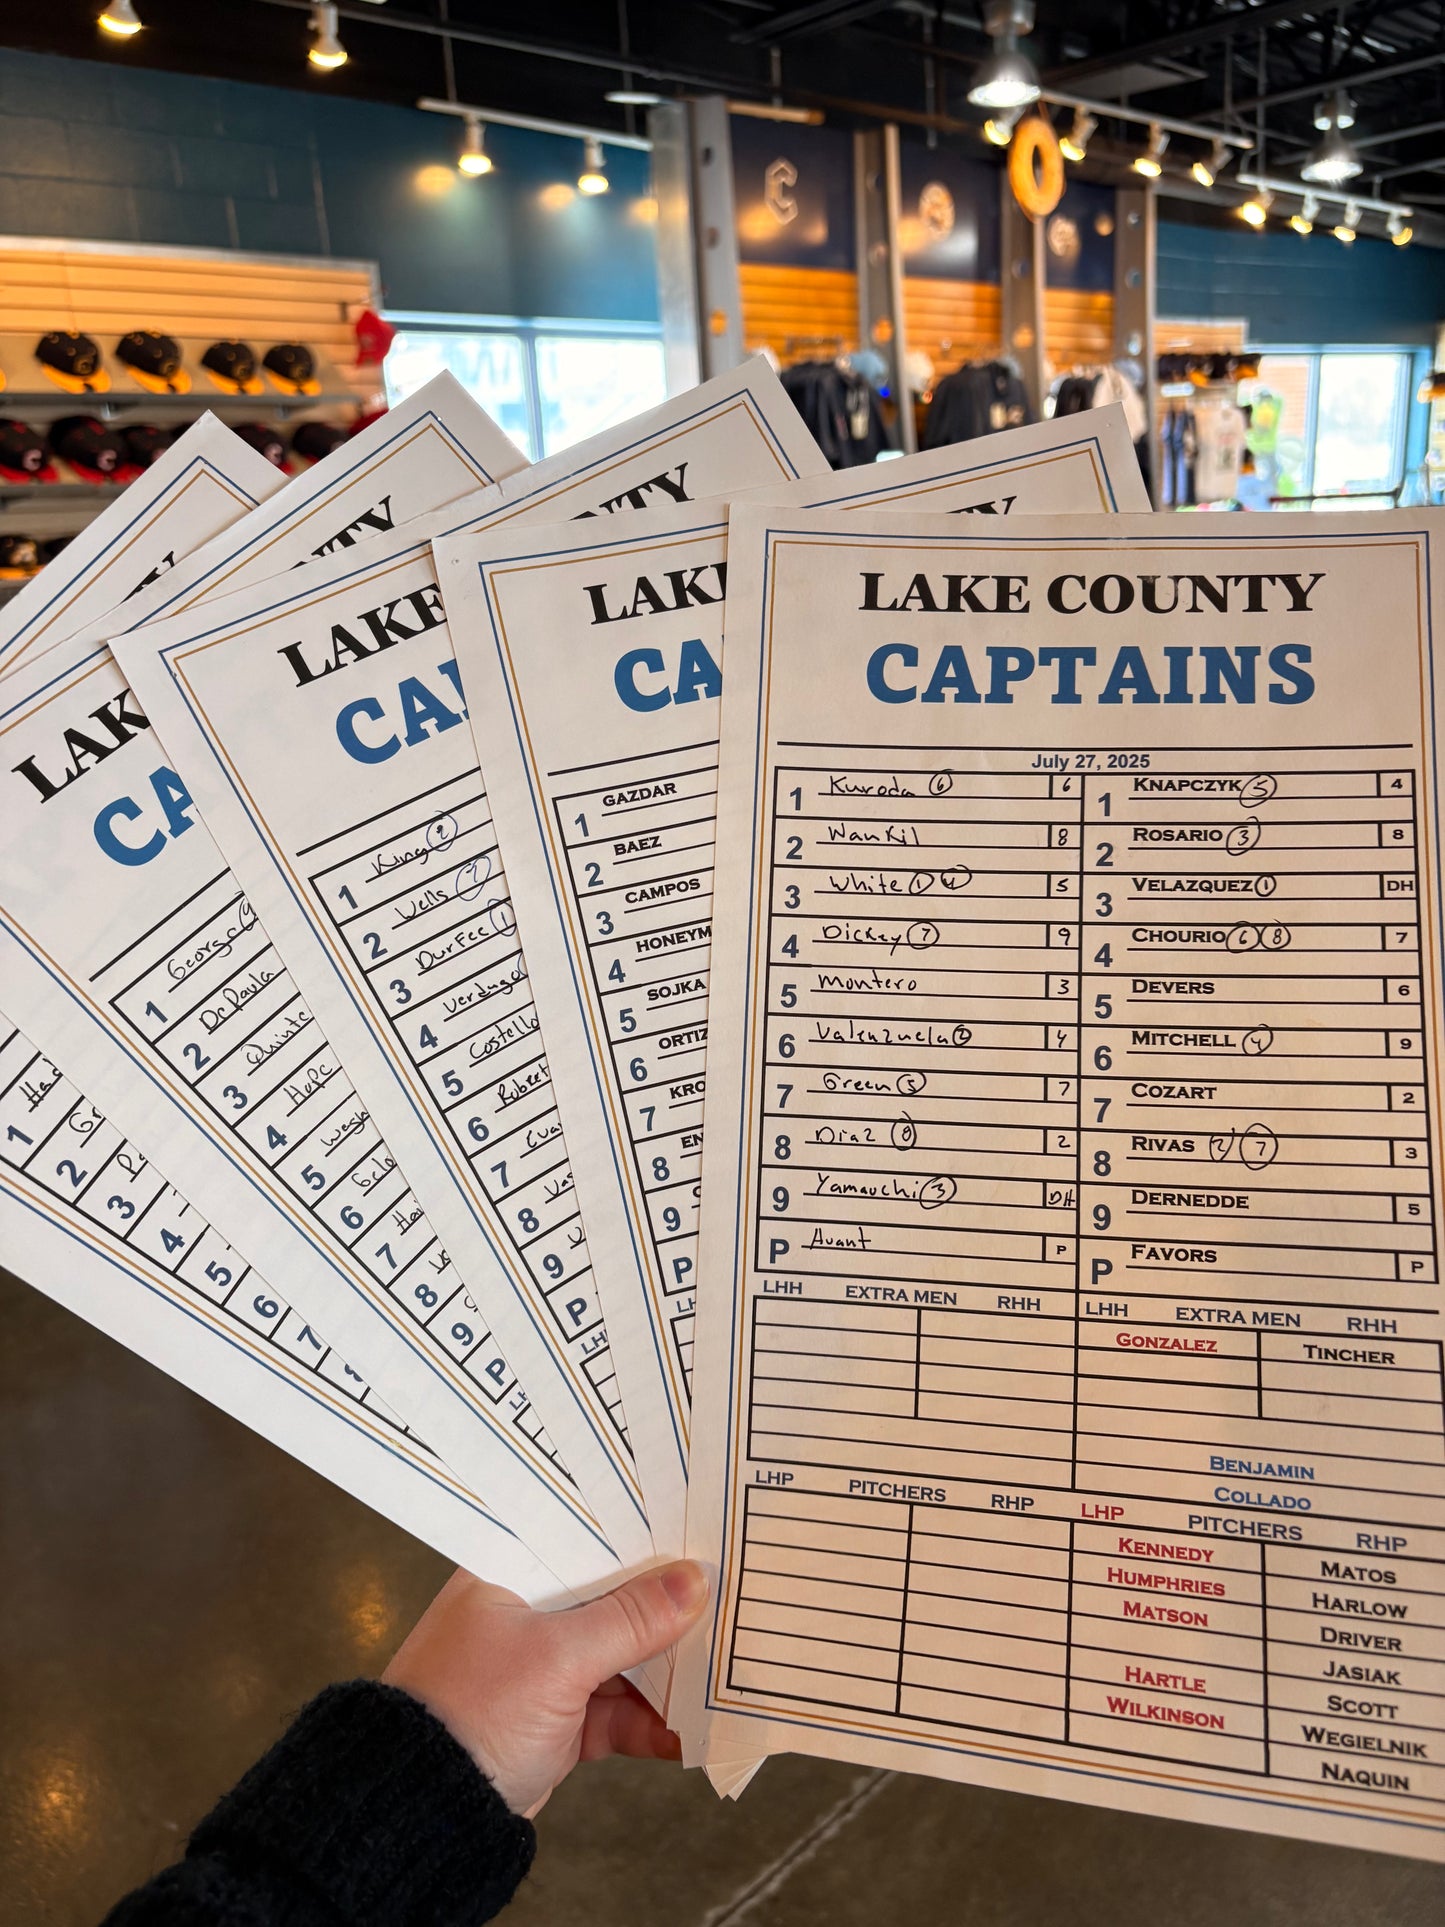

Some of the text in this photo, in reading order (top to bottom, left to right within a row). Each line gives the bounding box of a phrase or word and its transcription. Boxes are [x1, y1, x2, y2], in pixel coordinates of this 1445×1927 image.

[583, 562, 727, 625] LAK
[859, 572, 1326, 614] LAKE COUNTY
[277, 582, 447, 687] LAKE
[866, 644, 1316, 704] CAPTAINS
[1032, 754, 1150, 772] July 27, 2025
[602, 783, 677, 806] GAZDAR
[830, 776, 916, 797] Kuroda
[1063, 779, 1070, 792] 6
[1134, 778, 1242, 792] KNAPCZYK
[1391, 778, 1403, 789] 4
[789, 787, 802, 810] 1
[1098, 793, 1111, 816] 1
[575, 814, 589, 837] 1
[1059, 829, 1068, 845] 8
[1133, 828, 1223, 842] ROSARIO
[1392, 829, 1404, 840] 8
[613, 836, 662, 855] BAEZ
[786, 836, 803, 859] 2
[1096, 842, 1113, 866] 2
[371, 847, 429, 875] King
[585, 862, 604, 887] 2
[830, 873, 903, 894] White
[1056, 879, 1068, 892] 5
[1132, 878, 1253, 893] VELAZQUEZ
[1387, 880, 1413, 891] DH
[339, 885, 358, 909] 1
[625, 878, 700, 903] CAMPOS
[784, 885, 800, 908] 3
[395, 890, 449, 920] Wells
[1096, 893, 1113, 917] 3
[596, 911, 614, 935] 3
[363, 933, 388, 959] 2
[636, 926, 712, 952] HONEYM
[782, 935, 799, 958] 4
[823, 923, 901, 956] Dickey
[1058, 928, 1070, 945] 9
[1132, 928, 1226, 943] CHOURIO
[1396, 932, 1408, 943] 7
[1094, 943, 1113, 967] 4
[608, 959, 626, 983] 4
[390, 979, 412, 1004] 3
[648, 979, 706, 1000] SOJKA
[781, 985, 797, 1008] 5
[1057, 979, 1069, 994] 3
[1132, 980, 1215, 994] DEVERS
[1398, 985, 1410, 996] 6
[146, 1001, 168, 1023] 1
[1094, 994, 1112, 1019] 5
[620, 1008, 636, 1032] 5
[420, 1024, 438, 1048] 4
[658, 1028, 708, 1049] ORTIZ
[817, 1020, 948, 1045] Valenzuela
[1057, 1030, 1067, 1048] 4
[1132, 1031, 1236, 1047] MITCHELL
[1400, 1038, 1412, 1049] 9
[183, 1043, 211, 1071] 2
[779, 1034, 795, 1058] 6
[630, 1058, 648, 1081] 6
[1094, 1046, 1112, 1071] 6
[442, 1070, 463, 1096] 5
[823, 1073, 891, 1091] Green
[1059, 1082, 1070, 1095] 7
[1132, 1083, 1217, 1099] COZART
[223, 1085, 248, 1109] 3
[777, 1084, 793, 1108] 7
[1402, 1092, 1414, 1104] 2
[640, 1106, 655, 1132] 7
[1094, 1098, 1112, 1123] 7
[7, 1125, 34, 1145] 1
[266, 1125, 288, 1149] 4
[468, 1116, 489, 1141] 6
[774, 1135, 791, 1160] 8
[1057, 1136, 1070, 1148] 2
[1132, 1136, 1194, 1152] RIVAS
[1405, 1148, 1418, 1159] 3
[56, 1160, 88, 1187] 2
[490, 1160, 509, 1188] 7
[652, 1156, 670, 1181] 8
[1093, 1151, 1111, 1176] 8
[301, 1164, 326, 1190] 5
[818, 1173, 919, 1199] Yamauchi
[107, 1195, 135, 1219] 3
[772, 1187, 789, 1211] 9
[1049, 1190, 1075, 1207] DH
[1132, 1190, 1249, 1209] DERNEDDE
[1408, 1204, 1420, 1215] 5
[340, 1205, 364, 1229] 6
[517, 1208, 540, 1233] 8
[663, 1207, 681, 1232] 9
[1093, 1204, 1111, 1230] 9
[160, 1228, 185, 1253] 4
[769, 1239, 790, 1263] P
[1057, 1245, 1067, 1255] P
[375, 1242, 397, 1269] 7
[1132, 1244, 1217, 1263] FAVORS
[204, 1261, 232, 1287] 5
[543, 1254, 564, 1279] 9
[672, 1257, 693, 1284] P
[1091, 1259, 1113, 1285] P
[1411, 1261, 1424, 1273] P
[253, 1295, 279, 1318] 6
[414, 1284, 438, 1308] 8
[763, 1280, 1041, 1311] LHH EXTRA MEN RHH
[565, 1297, 587, 1327] P
[1086, 1302, 1397, 1334] LHH EXTRA MEN RHH
[296, 1325, 322, 1351] 7
[451, 1322, 474, 1346] 9
[1116, 1333, 1218, 1353] GONZALEZ
[1303, 1344, 1395, 1364] TINCHER
[485, 1358, 506, 1386] P
[1210, 1456, 1315, 1480] BENJAMIN
[755, 1470, 1034, 1511] LHP PITCHERS RHP
[1214, 1487, 1311, 1510] COLLADO
[1081, 1504, 1407, 1551] LHP PITCHERS RHP
[1118, 1537, 1214, 1562] KENNEDY
[1107, 1567, 1225, 1596] HUMPHRIES
[1321, 1561, 1396, 1584] MATOS
[1123, 1601, 1208, 1627] MATSON
[1312, 1593, 1408, 1618] HARLOW
[1320, 1626, 1402, 1651] DRIVER
[1125, 1666, 1206, 1693] HARTLE
[1323, 1661, 1401, 1686] JASIAK
[1106, 1696, 1225, 1729] WILKINSON
[1327, 1695, 1398, 1719] SCOTT
[1301, 1725, 1428, 1758] WEGIELNIK
[1321, 1762, 1409, 1790] NAQUIN
